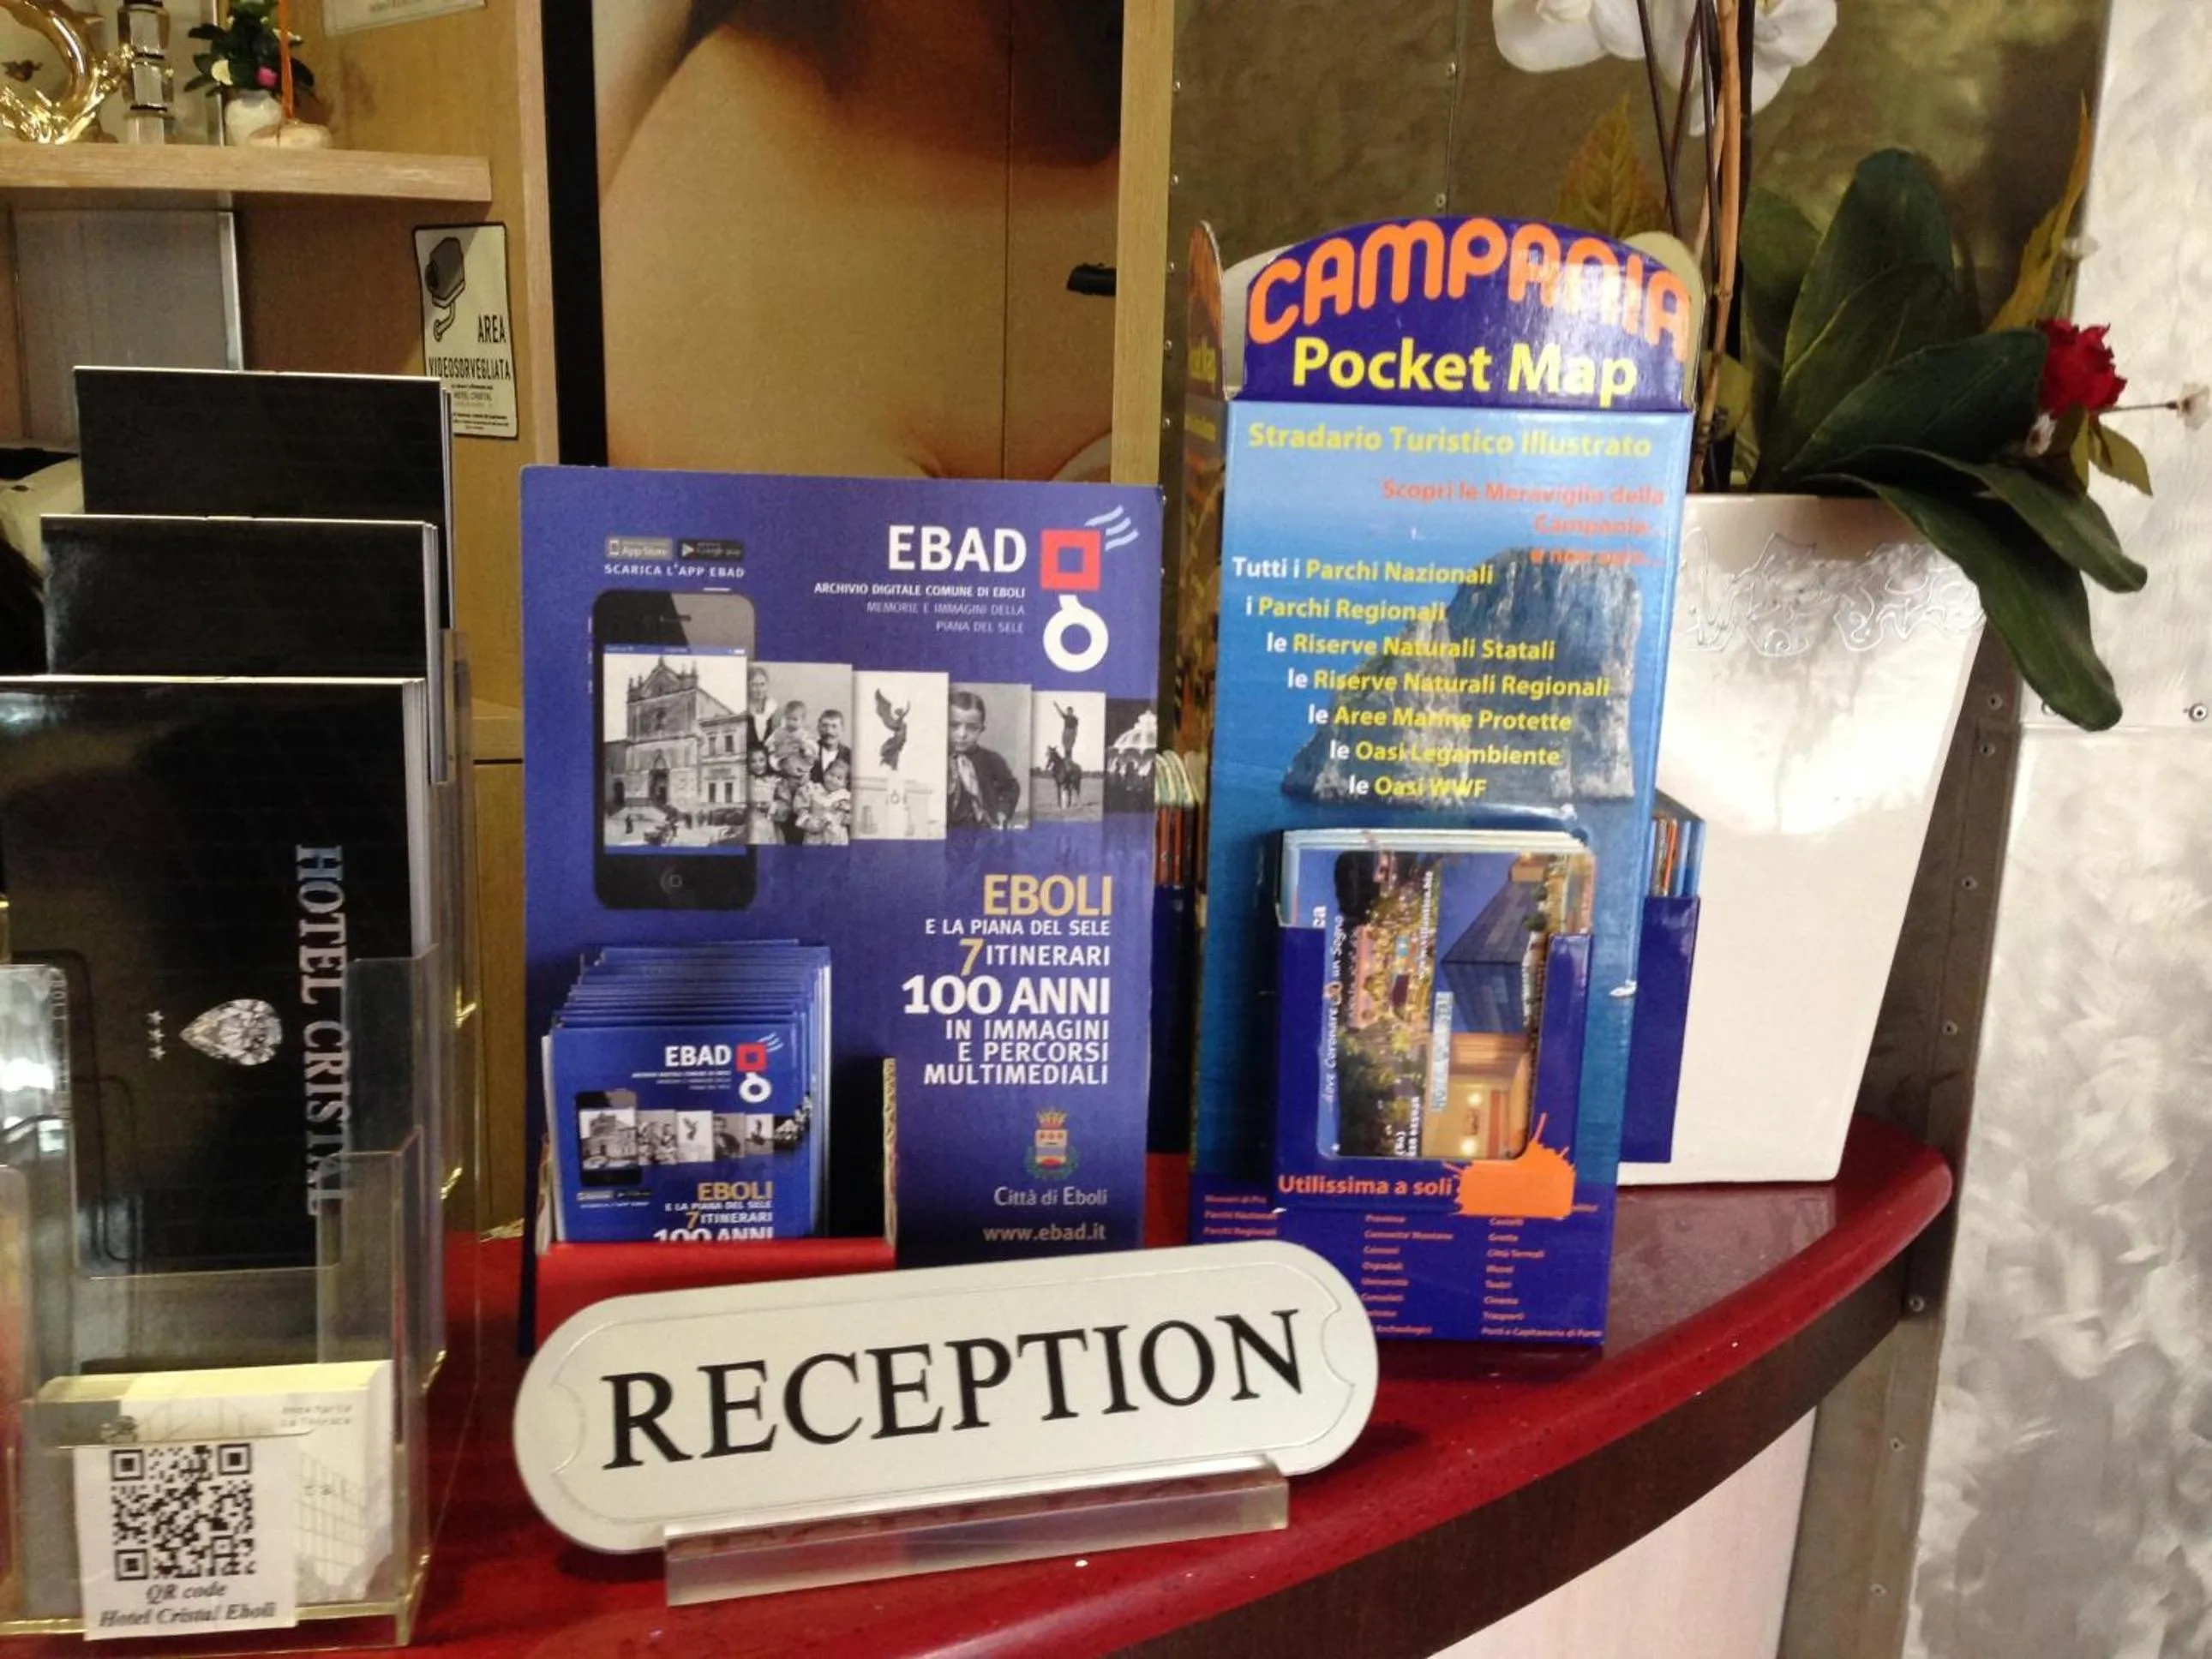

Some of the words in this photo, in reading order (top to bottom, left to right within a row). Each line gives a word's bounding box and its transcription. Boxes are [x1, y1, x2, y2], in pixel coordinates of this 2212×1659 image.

[1249, 218, 1691, 362] CAMPANIA
[477, 314, 506, 343] AREA
[429, 356, 511, 380] VIDEOSORVEGLIATA
[1293, 337, 1491, 392] Pocket
[1508, 342, 1638, 408] Map
[1249, 422, 1382, 452] Stradario
[1390, 426, 1514, 455] Turistico
[1521, 429, 1652, 458] Illustrato
[1382, 479, 1454, 506] Scopri
[1459, 482, 1478, 500] le
[1612, 486, 1663, 505] della
[889, 525, 1027, 572] EBAD
[604, 564, 662, 577] SCARICA
[667, 564, 704, 577] L'APP
[710, 566, 746, 578] EBAD
[1232, 557, 1286, 578] Tutti
[1293, 558, 1300, 578] i
[1306, 560, 1378, 582] Parchi
[1384, 561, 1493, 585] Nazionali
[814, 582, 868, 595] ARCHIVIO
[872, 584, 920, 596] DIGITALE
[926, 585, 973, 597] COMUNE
[977, 586, 989, 597] DI
[993, 587, 1025, 598] EBOLI
[866, 602, 918, 614] MEMORIE
[923, 602, 929, 614] E
[934, 603, 986, 614] IMMAGINI
[991, 605, 1024, 615] DELLA
[1246, 596, 1253, 615] i
[1259, 596, 1330, 618] Parchi
[1336, 598, 1446, 624] Regionali
[937, 621, 970, 632] PIANA
[974, 622, 992, 632] DEL
[998, 622, 1024, 633] SELE
[1267, 632, 1287, 652] le
[1292, 634, 1376, 655] Riserve
[1383, 637, 1476, 658] Naturali
[1482, 638, 1556, 661] Statali
[1288, 668, 1308, 688] le
[1313, 669, 1397, 691] Riserve
[1403, 672, 1496, 694] Naturali
[1502, 674, 1610, 700] Regionali
[1309, 704, 1328, 724] le
[1334, 706, 1387, 726] Aree
[1392, 708, 1472, 728] Marine
[1478, 710, 1572, 731] Protette
[1330, 740, 1350, 760] le
[1356, 742, 1405, 762] Oasi
[1411, 743, 1561, 766] Legambiente
[1349, 775, 1369, 794] le
[1374, 776, 1423, 796] Oasi
[1429, 779, 1486, 798] WWF
[984, 874, 1112, 916] EBOLI
[296, 844, 347, 1005] HOTEL
[926, 919, 936, 934] E
[943, 919, 963, 934] LA
[970, 919, 1024, 935] PIANA
[1031, 920, 1061, 936] DEL
[1069, 920, 1111, 936] SELE
[1330, 914, 1346, 955] Sogno
[959, 937, 985, 977] 7
[986, 945, 1111, 966] ITINERARI
[902, 975, 1003, 1015] 100
[1008, 978, 1111, 1015] ANNI
[946, 1020, 971, 1039] IN
[985, 1020, 1109, 1040] IMMAGINI
[664, 1045, 732, 1067] EBAD
[958, 1043, 971, 1062] E
[984, 1042, 1108, 1063] PERCORSI
[924, 1064, 1108, 1085] MULTIMEDIALI
[303, 1020, 354, 1217] CRISTAL
[697, 1181, 774, 1201] EBOLI
[994, 1186, 1036, 1206] Città
[1040, 1189, 1058, 1206] di
[1063, 1187, 1108, 1206] Eboli
[1278, 1175, 1388, 1195] Utilissima
[1395, 1181, 1407, 1195] a
[1413, 1177, 1453, 1196] soli
[675, 1202, 687, 1211] LA
[686, 1210, 701, 1229] 7
[700, 1212, 773, 1224] ITINERARI
[716, 1226, 774, 1240] ANNI
[982, 1224, 1106, 1241] www.ebad.it
[602, 1309, 1304, 1471] RECEPTION
[147, 1584, 177, 1605] QR
[183, 1581, 227, 1600] code
[99, 1608, 153, 1627] Hotel
[156, 1605, 223, 1625] Cristal
[225, 1602, 277, 1620] Eboli
